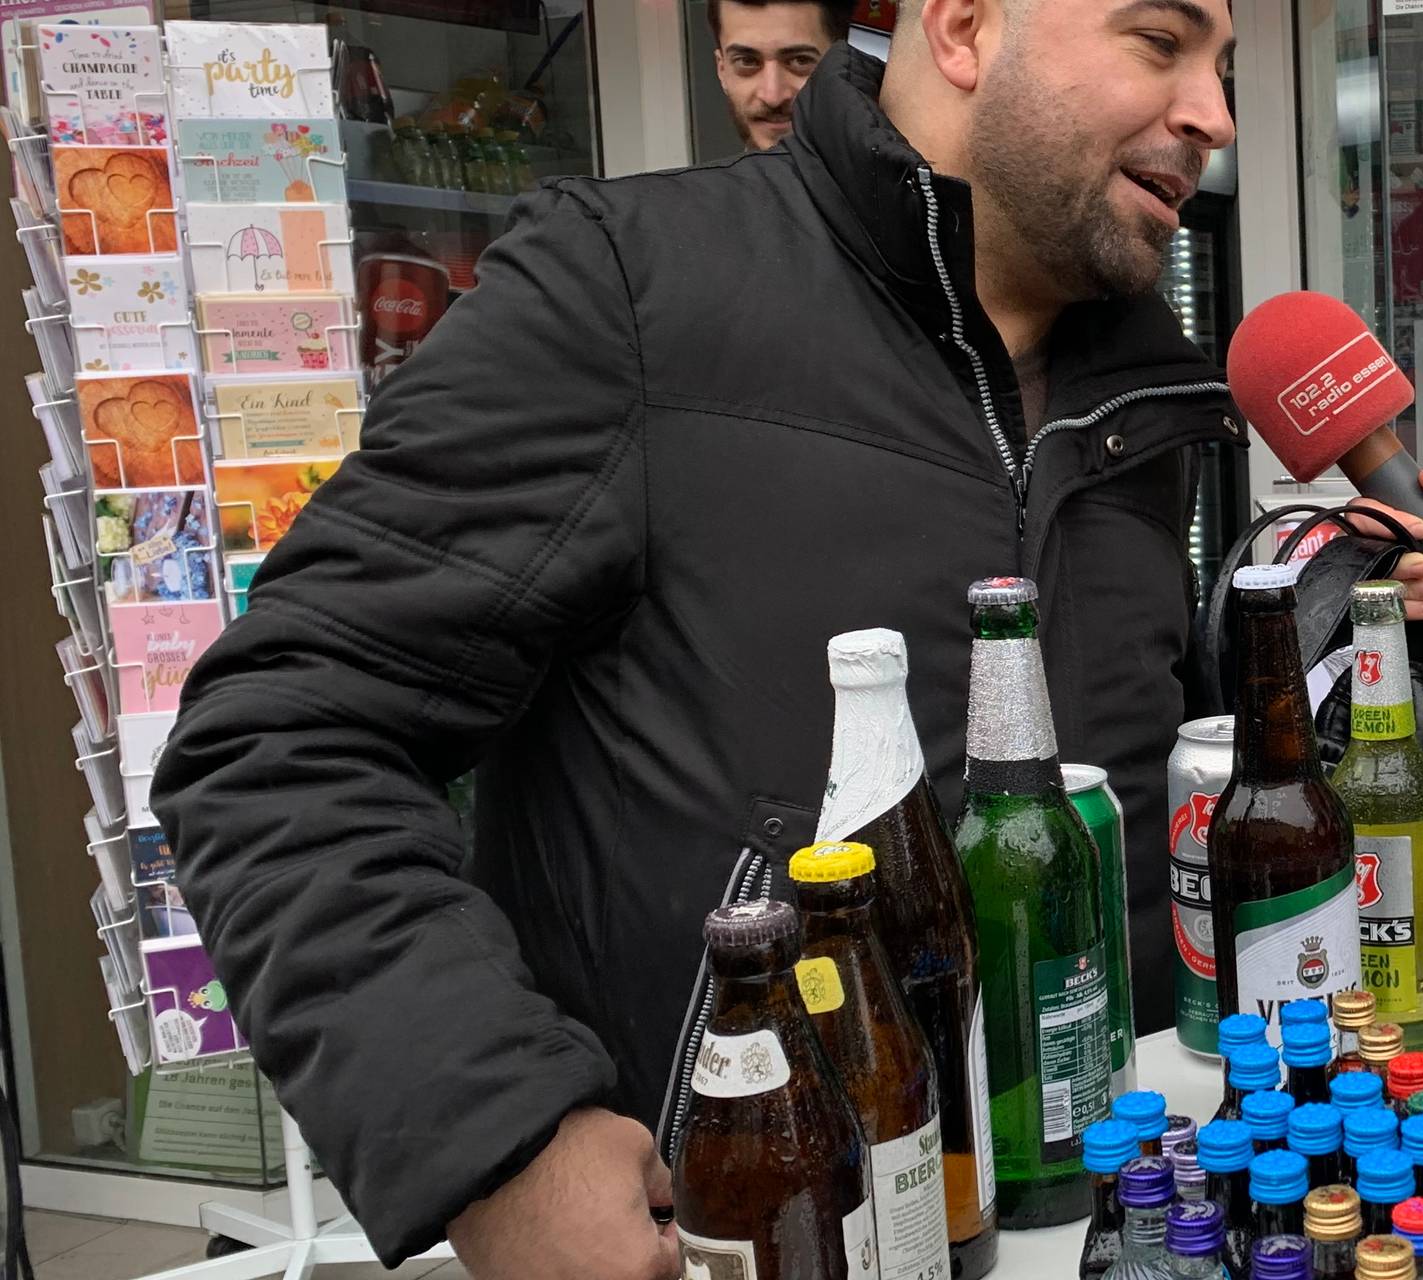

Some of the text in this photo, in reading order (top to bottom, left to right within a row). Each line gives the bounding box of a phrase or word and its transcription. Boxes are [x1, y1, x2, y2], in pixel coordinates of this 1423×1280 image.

[217, 48, 236, 64] it's
[62, 62, 138, 75] CHAMPAGNE
[203, 48, 296, 99] party
[86, 89, 122, 100] TABLE
[248, 83, 280, 98] time
[1289, 372, 1336, 410] 102.2
[1308, 355, 1389, 417] radio essen
[1360, 920, 1412, 942] CK'S
[184, 1072, 226, 1086] Jahren
